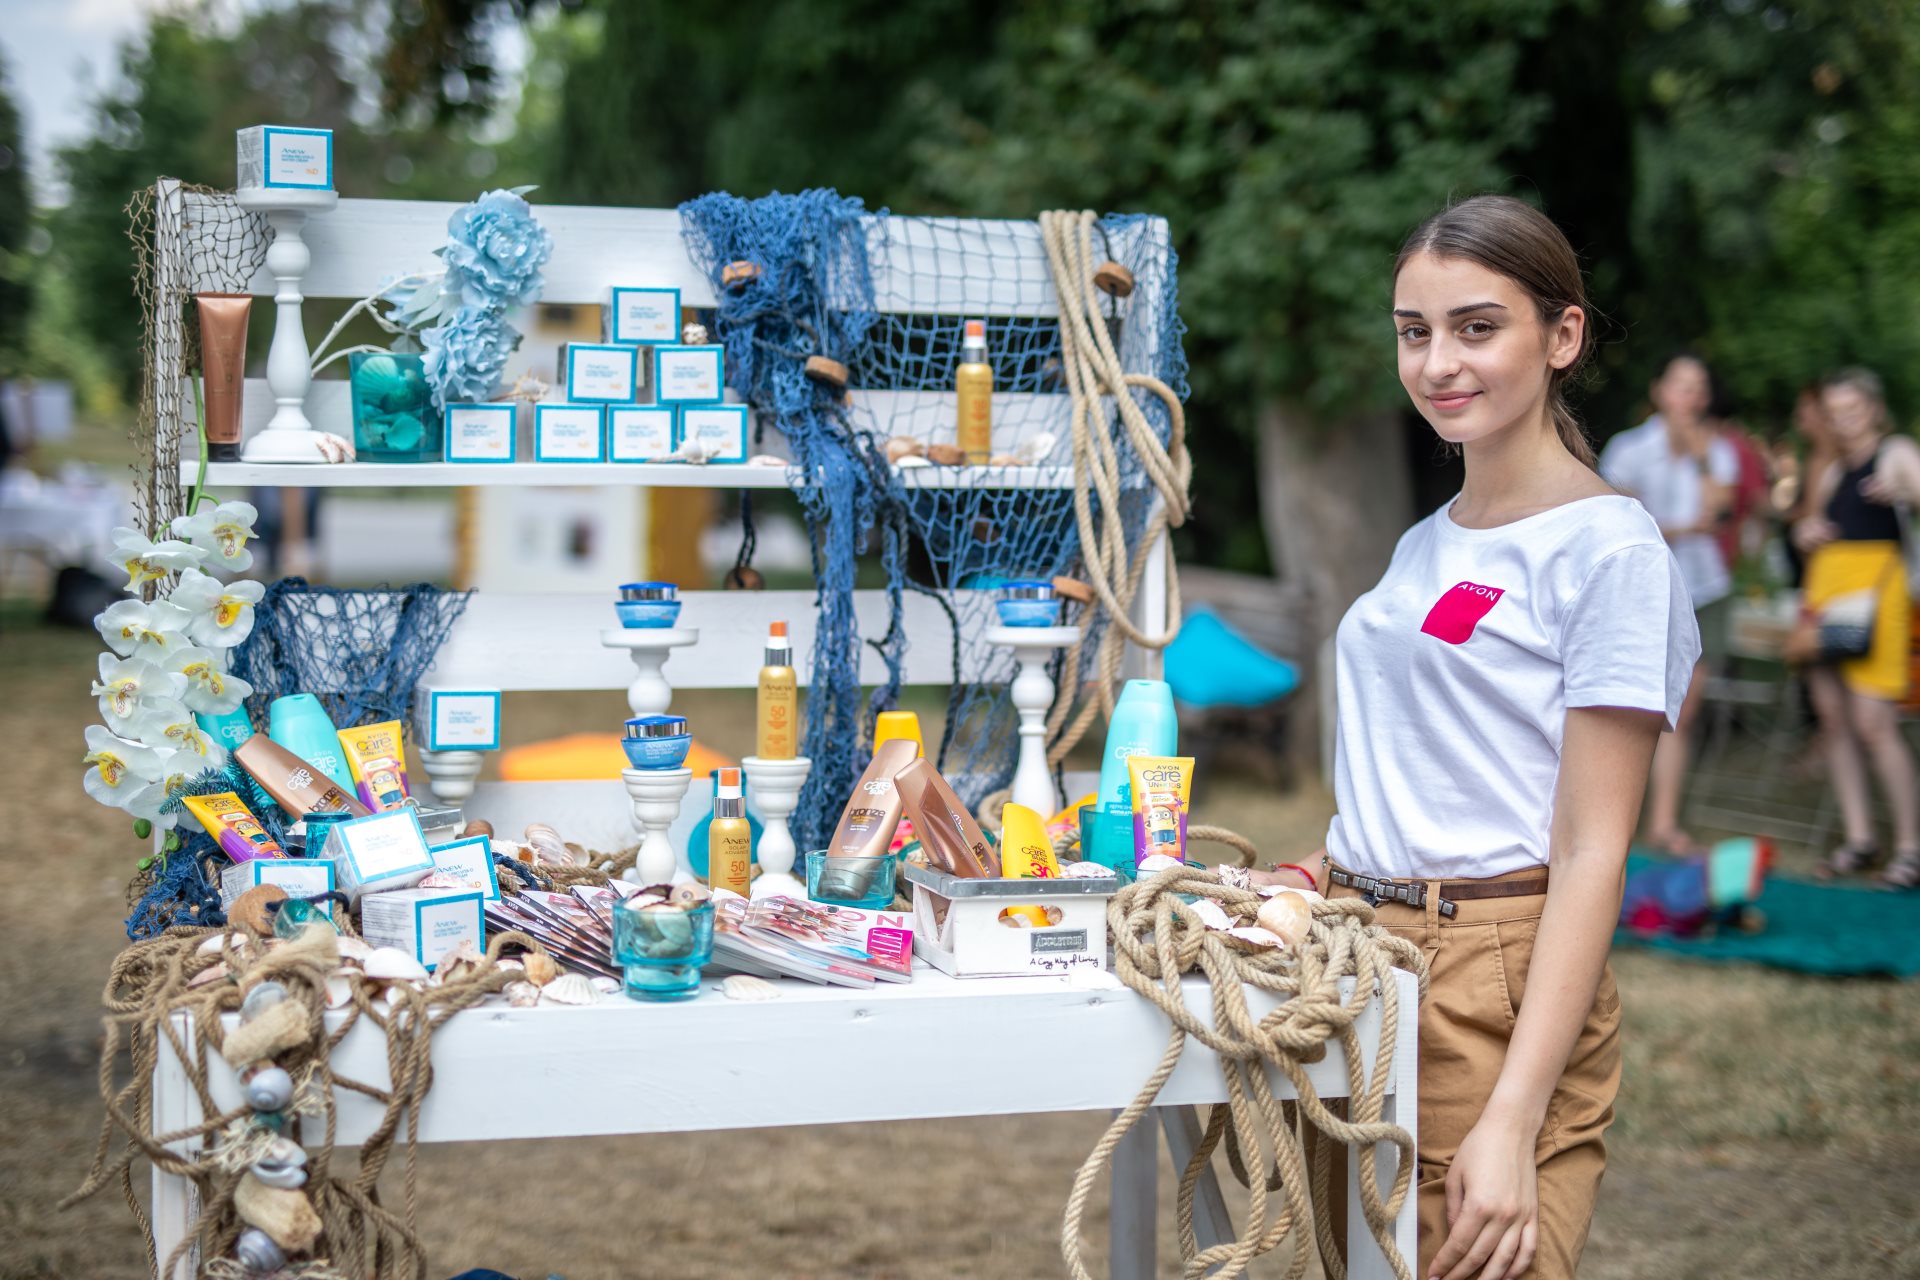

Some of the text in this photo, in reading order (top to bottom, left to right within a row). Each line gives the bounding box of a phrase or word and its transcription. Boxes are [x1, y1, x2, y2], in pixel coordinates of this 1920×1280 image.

[1458, 583, 1498, 602] AVON
[1142, 769, 1181, 783] care
[308, 786, 339, 813] bronze
[849, 807, 887, 818] bronze
[722, 837, 750, 845] ANEW
[436, 863, 463, 874] ANEW
[730, 860, 746, 873] 50
[1030, 861, 1055, 878] 30
[1030, 957, 1036, 966] A
[1069, 953, 1077, 966] of
[1078, 954, 1099, 968] Living
